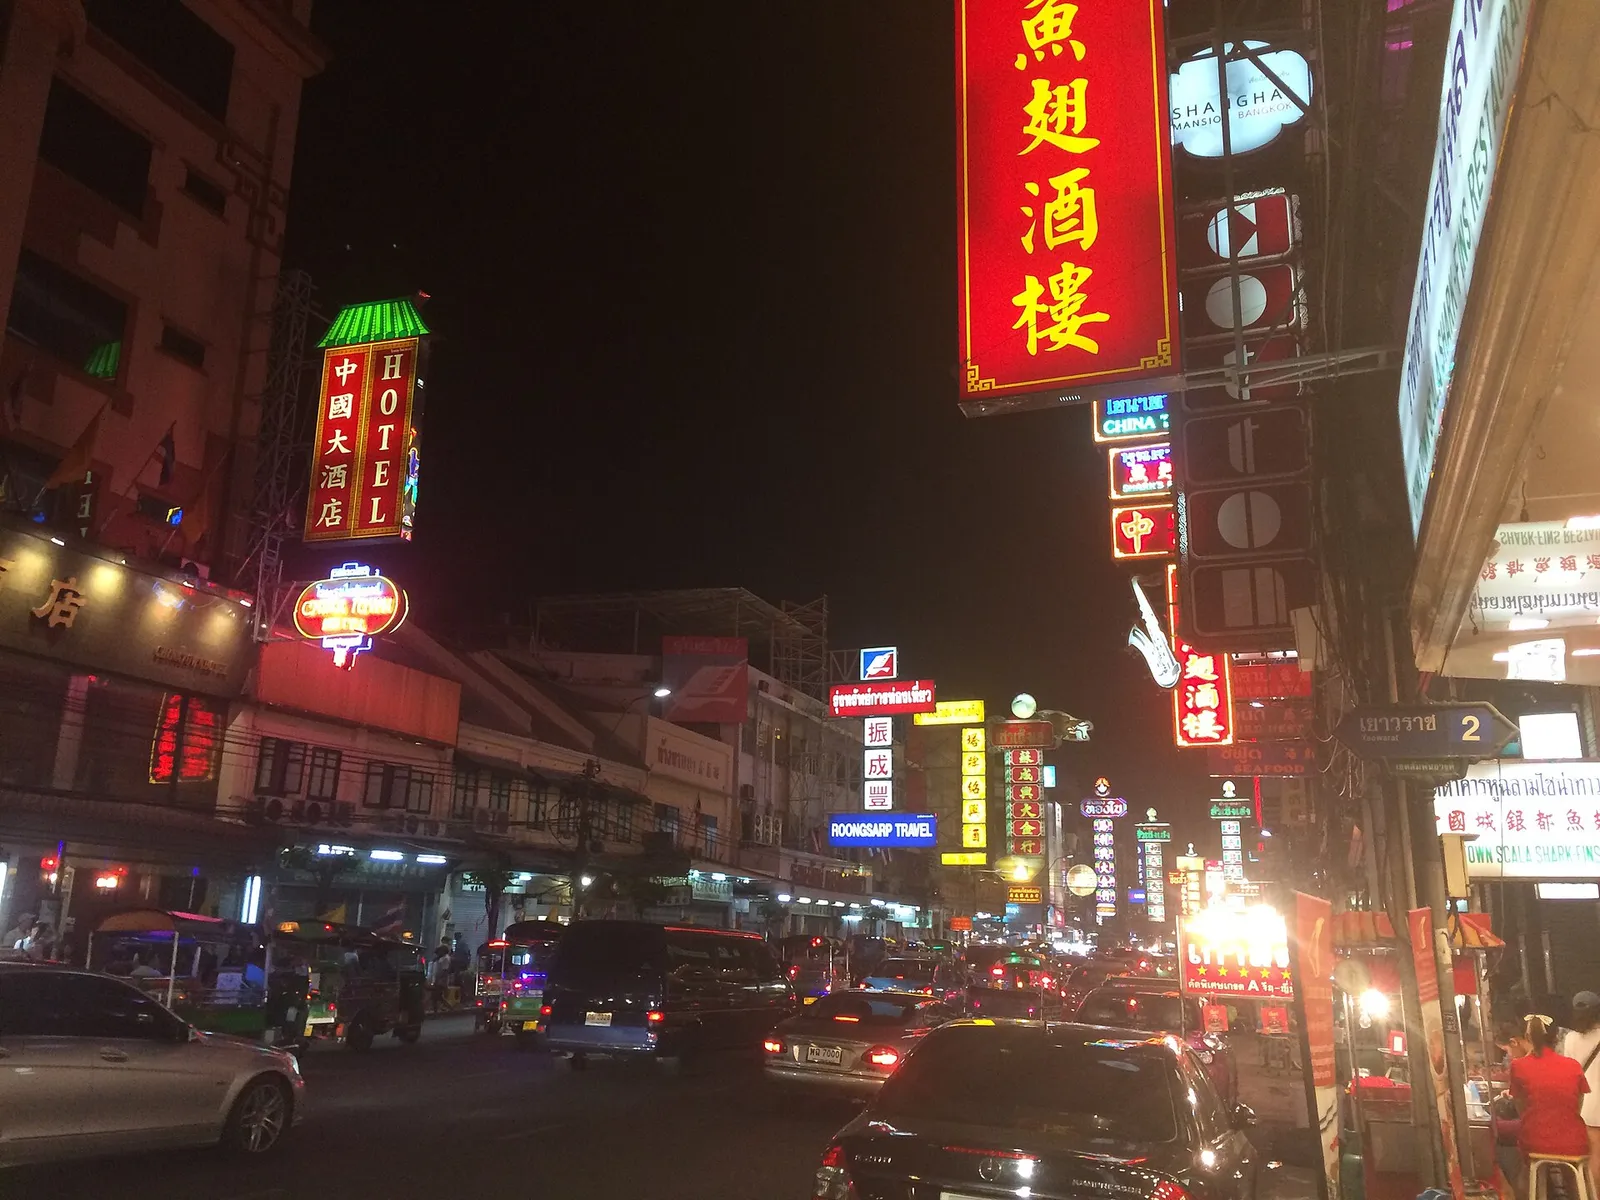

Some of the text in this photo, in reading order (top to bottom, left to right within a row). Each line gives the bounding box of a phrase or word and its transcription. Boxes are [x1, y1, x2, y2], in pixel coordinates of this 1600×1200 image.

[1173, 89, 1283, 120] SHAGHA
[1174, 101, 1293, 131] MANSIO BANGKOK
[1011, 0, 1111, 356] 魚翅酒樓
[369, 354, 404, 524] HOTEL
[1103, 415, 1157, 434] CHINA
[315, 357, 358, 528] 中國大酒店
[1121, 510, 1154, 554] 中
[1360, 713, 1481, 741] เยาวราช 2
[868, 722, 888, 807] 振成豐
[1233, 764, 1305, 774] SEAFOOD
[831, 822, 933, 838] ROONGSARP TRAVEL
[1465, 845, 1494, 864] OWN
[1496, 845, 1533, 864] SCALA
[1248, 979, 1260, 992] A
